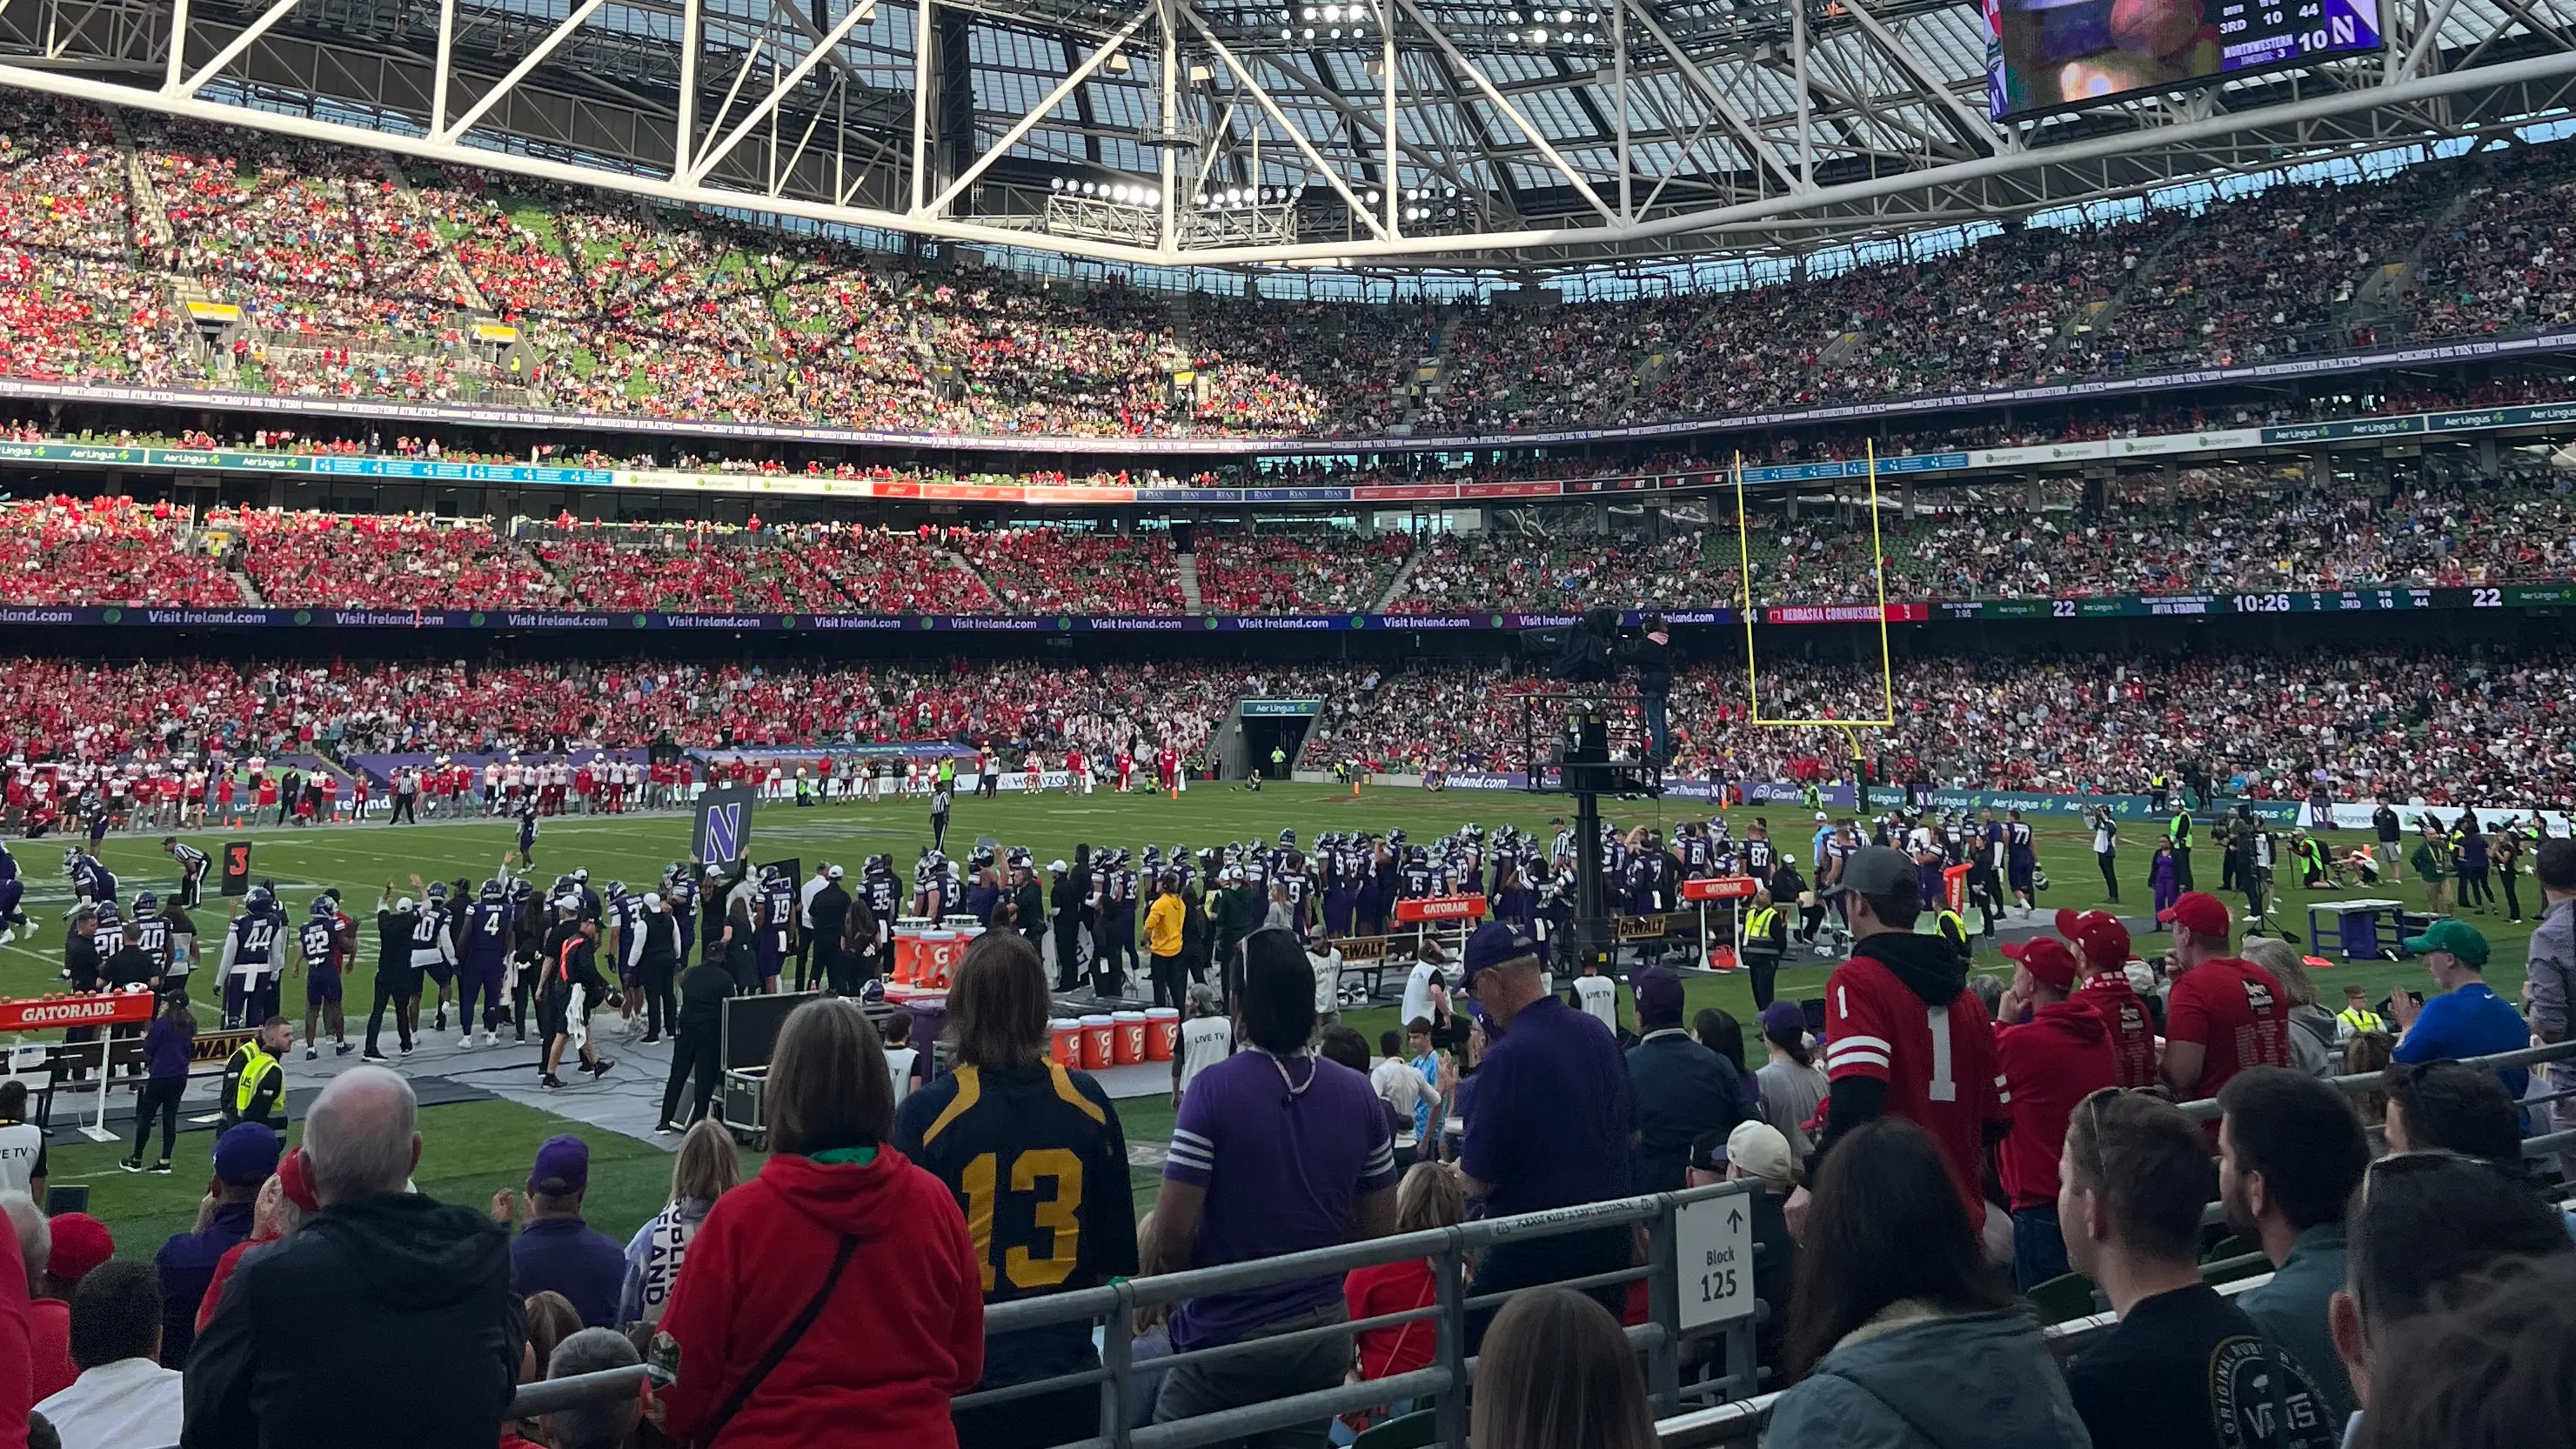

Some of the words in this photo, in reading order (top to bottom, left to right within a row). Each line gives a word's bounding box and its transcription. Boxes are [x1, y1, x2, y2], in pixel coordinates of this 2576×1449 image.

[2298, 3, 2319, 17] 44
[2263, 10, 2283, 25] 10
[2219, 19, 2247, 34] 3RD
[2332, 15, 2355, 44] N
[2224, 34, 2293, 58] NORTHWESTERN
[2298, 29, 2328, 52] 10
[2278, 48, 2286, 58] 3
[2398, 348, 2439, 362] CHICAGO'S
[2453, 344, 2472, 356] TEN
[2472, 342, 2497, 354] TEAM
[2318, 357, 2361, 369] ATHLETICS
[130, 390, 174, 401] ATHLETICS
[210, 395, 249, 406] CHICAGO'S
[2530, 411, 2546, 419] Aer
[1324, 489, 1342, 497] RYAN
[2233, 594, 2291, 612] 10:26
[2339, 599, 2361, 609] 3RD
[2379, 598, 2393, 608] 10
[2413, 598, 2429, 607] 44
[2472, 589, 2502, 607] 22
[2052, 600, 2076, 617] 22
[2312, 601, 2321, 610] 2
[149, 611, 181, 623] Visit
[184, 611, 266, 624] Ireland.com
[335, 613, 365, 624] Visit
[507, 614, 536, 625] Visit
[539, 614, 608, 626] Ireland.com
[1519, 615, 1541, 626] Visit
[1783, 609, 1823, 621] NEBRASKA
[1826, 606, 1883, 620] CORNHUSKERS
[667, 616, 693, 627] Visit
[695, 616, 760, 627] Ireland.com
[814, 617, 839, 628] Visit
[840, 617, 900, 628] Ireland.com
[951, 618, 974, 629] Visit
[975, 618, 1037, 629] Ireland.com
[1091, 618, 1115, 629] Visit
[1118, 618, 1181, 629] Ireland.com
[1237, 618, 1263, 629] Visit
[1265, 618, 1329, 629] Ireland.com
[1383, 617, 1408, 628] Visit
[1409, 616, 1469, 627] Ireland.com
[1270, 704, 1295, 713] Lingus
[1445, 774, 1509, 789] Ireland.com
[1711, 785, 1718, 798] N
[1771, 788, 1794, 800] Grant
[1917, 792, 1924, 805] N
[1873, 795, 1899, 805] Lingus
[1938, 796, 1967, 808] Lingus
[1991, 798, 2008, 809] Aer
[2009, 798, 2038, 811] Lingus
[2313, 806, 2324, 822] N
[703, 803, 740, 865] N
[2015, 828, 2030, 845] 77
[230, 847, 248, 876] 3
[1751, 847, 1769, 867] 87
[1288, 881, 1301, 905] 9
[1705, 881, 1741, 893] GATORADE
[872, 891, 891, 911] 35
[1423, 901, 1469, 914] GATORADE
[772, 899, 791, 925] 19
[485, 911, 499, 936] 4
[138, 929, 164, 951] 40
[244, 925, 273, 952] 44
[304, 931, 330, 955] 22
[935, 947, 950, 965] G
[1343, 942, 1383, 958] EWALT
[1602, 989, 1611, 998] TV
[1837, 985, 1849, 1019] 1
[22, 1002, 115, 1021] GATORADE
[1101, 1032, 1111, 1045] G
[1132, 1027, 1142, 1041] G
[1168, 1025, 1177, 1038] G
[1194, 1034, 1212, 1044] LIVE
[1214, 1032, 1225, 1041] TV
[1070, 1036, 1079, 1050] G
[1927, 1005, 1957, 1101] 1
[14, 1146, 28, 1158] TV
[961, 1147, 1082, 1292] 13
[1516, 1215, 1546, 1228] PLEASE
[1547, 1212, 1565, 1223] KEEP
[1706, 1246, 1735, 1265] Block
[1700, 1269, 1736, 1303] 125
